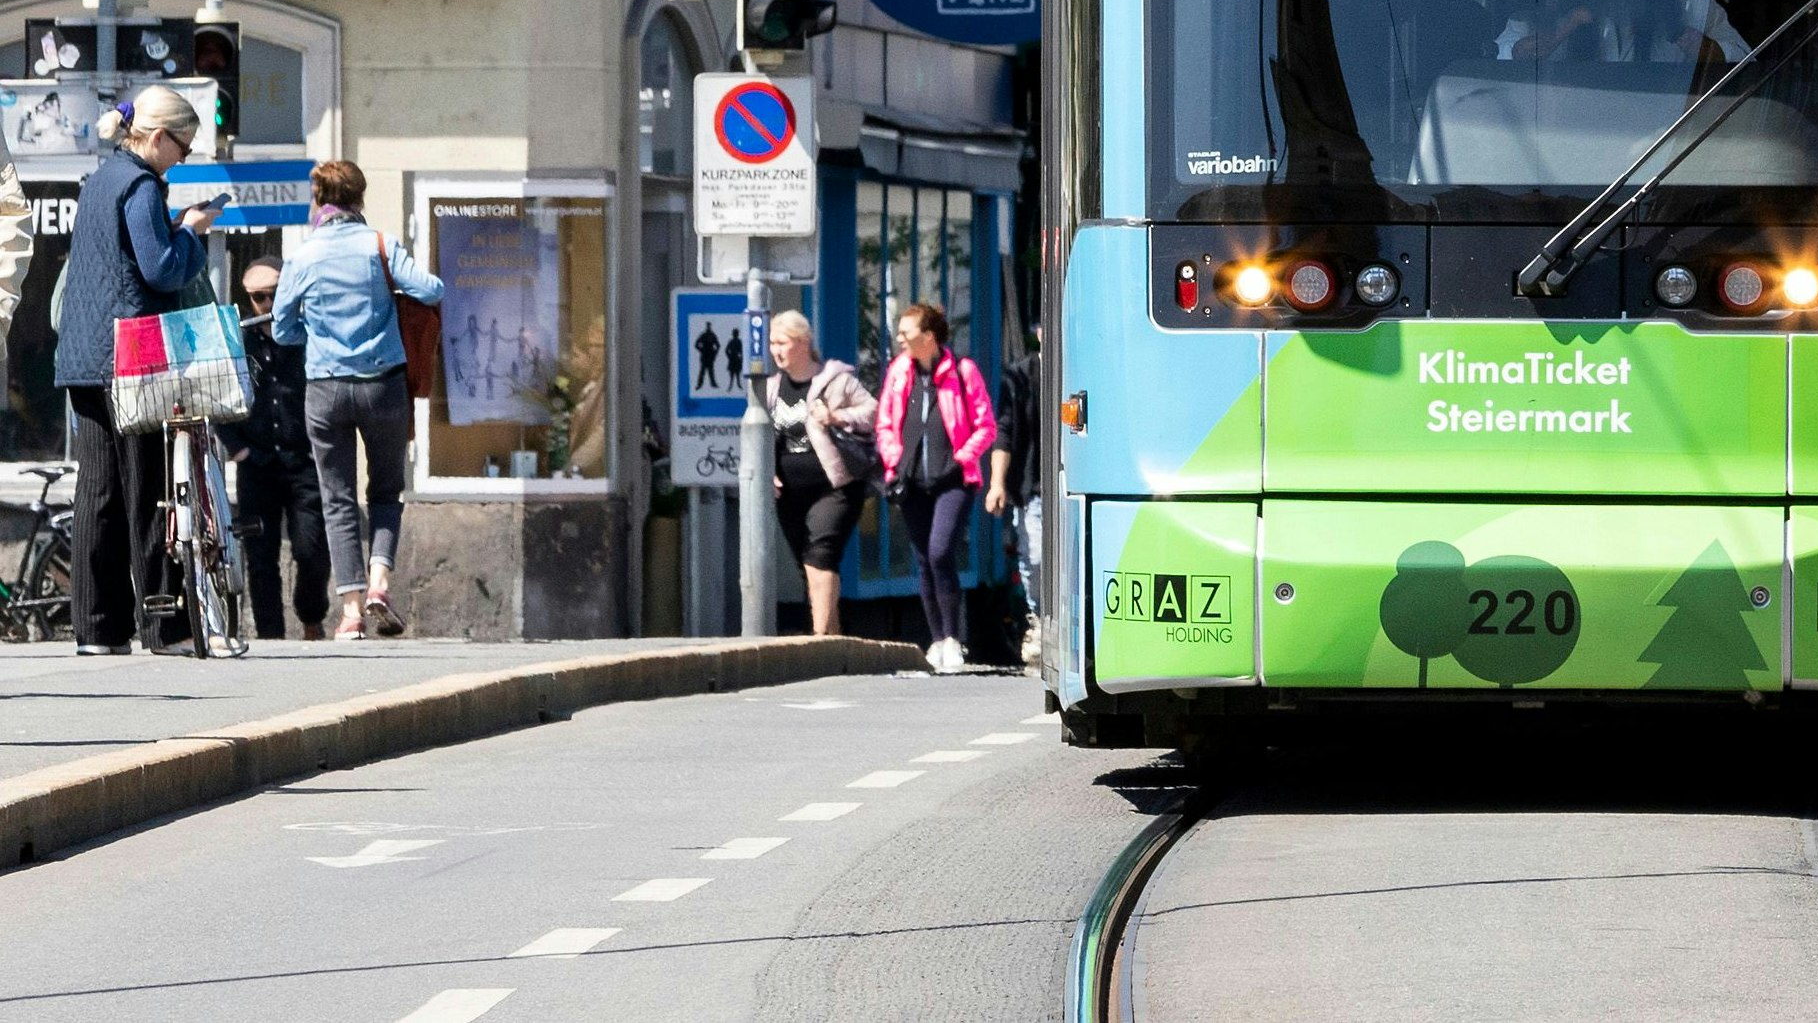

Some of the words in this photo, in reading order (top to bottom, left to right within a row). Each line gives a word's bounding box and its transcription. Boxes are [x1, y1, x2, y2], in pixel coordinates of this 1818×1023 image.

[701, 169, 808, 180] KURZPARKZONE
[1187, 155, 1278, 175] variobahn
[433, 204, 518, 217] ONLINESTORE
[1418, 349, 1632, 385] KlimaTicket
[1426, 399, 1633, 433] Steiermark
[1104, 574, 1227, 620] GRAZ
[1467, 589, 1575, 635] 220
[1166, 627, 1233, 643] HOLDING
